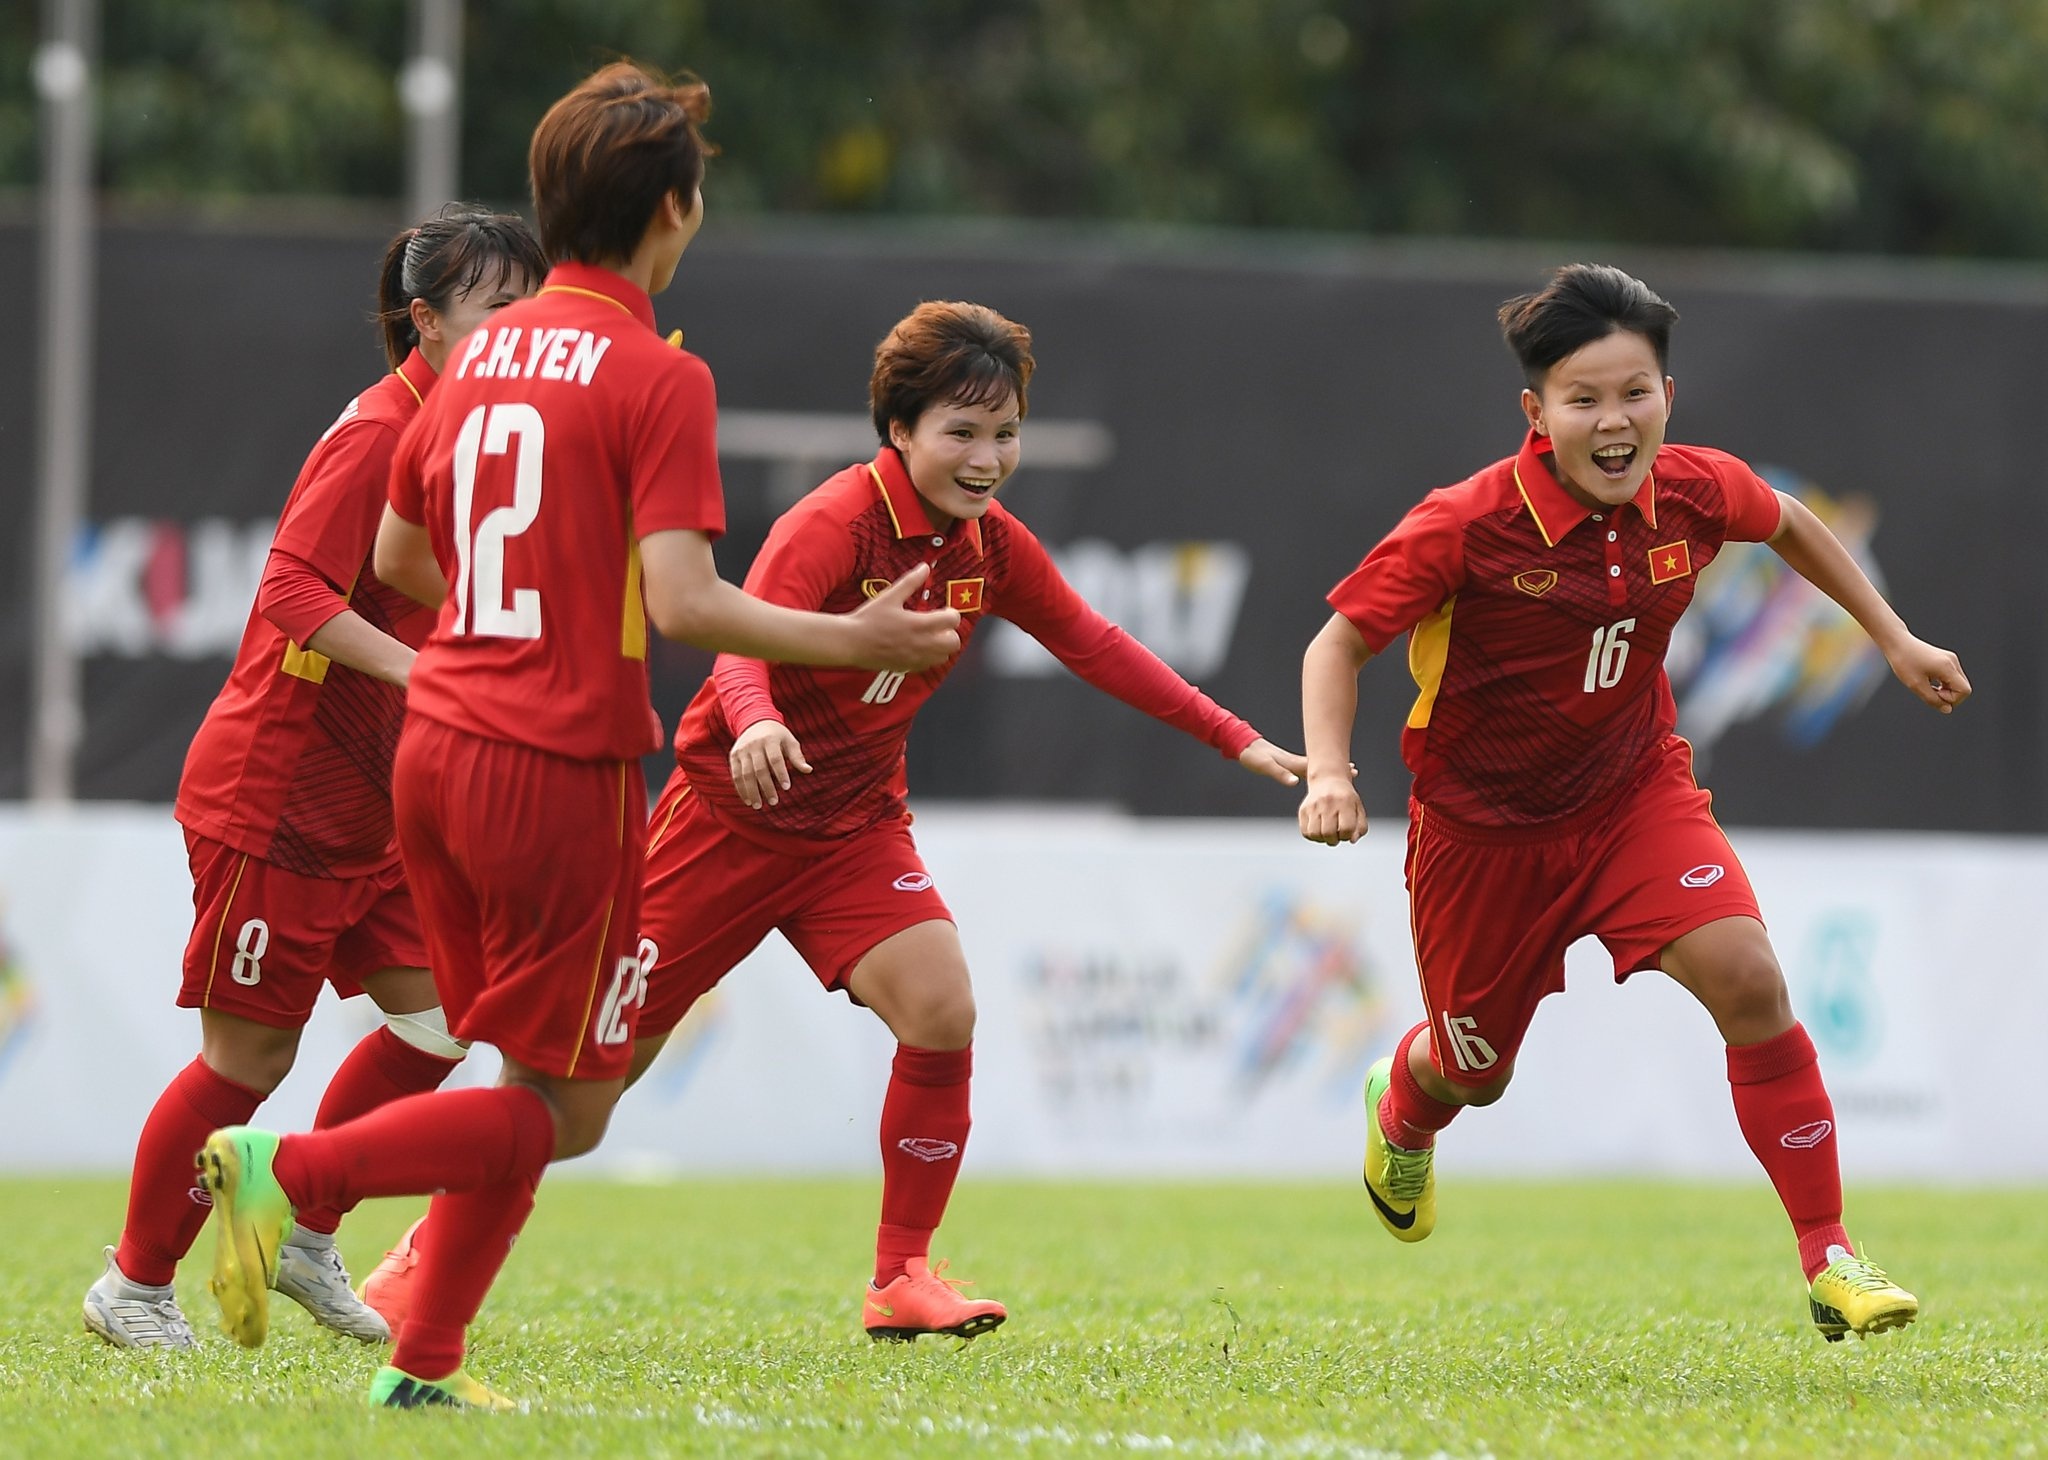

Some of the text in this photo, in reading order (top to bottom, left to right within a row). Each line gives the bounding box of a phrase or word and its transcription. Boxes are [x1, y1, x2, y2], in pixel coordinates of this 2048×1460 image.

[456, 327, 612, 386] P.H.YEN
[452, 403, 545, 639] 12
[1584, 617, 1636, 693] 16
[231, 917, 270, 986] 8
[596, 956, 641, 1045] 12
[1442, 1010, 1499, 1071] 16
